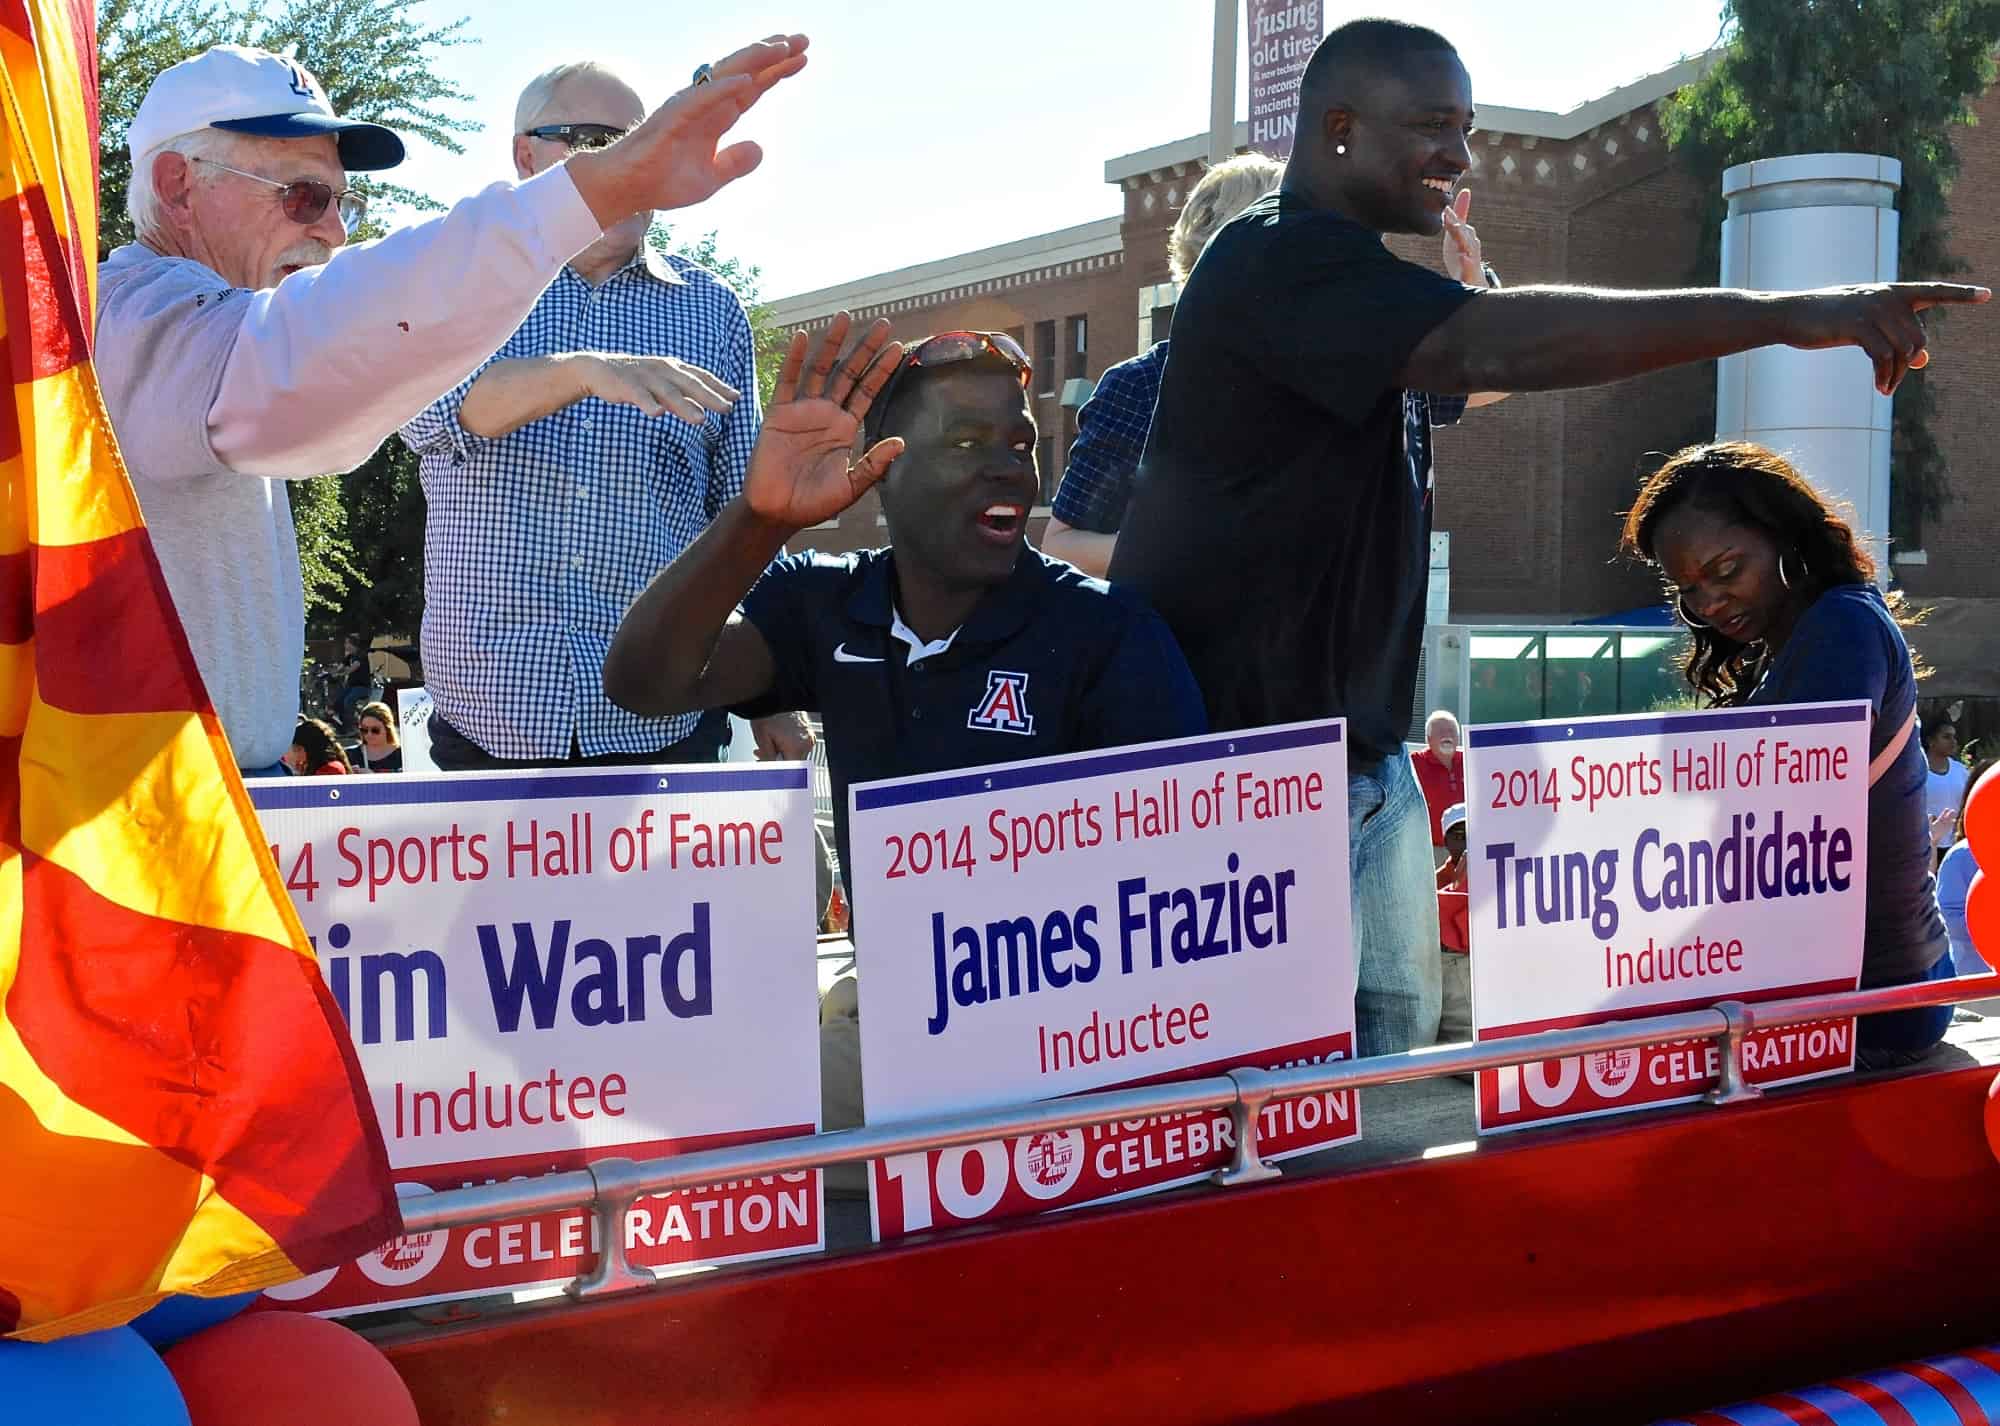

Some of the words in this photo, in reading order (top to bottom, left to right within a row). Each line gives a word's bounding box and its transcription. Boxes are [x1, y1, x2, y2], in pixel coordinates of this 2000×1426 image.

[1251, 1, 1318, 47] fusing
[1253, 39, 1279, 66] old
[1282, 34, 1319, 59] tires
[1254, 86, 1266, 98] to
[1254, 97, 1292, 116] ancient
[967, 670, 1033, 735] A
[1491, 767, 1561, 812] 2014
[1570, 751, 1662, 812] Sports
[1672, 741, 1726, 793] Hall
[1736, 738, 1765, 788] of
[1775, 740, 1849, 785] Fame
[336, 823, 489, 902] Sports
[507, 812, 593, 879] Hall
[608, 809, 654, 873] of
[669, 813, 783, 870] Fame
[885, 825, 976, 879] 2014
[989, 798, 1102, 873] Sports
[1114, 778, 1180, 842] Hall
[1191, 770, 1225, 829] of
[1236, 771, 1323, 825] Fame
[1486, 841, 1619, 940] Trung
[1632, 810, 1853, 912] Candidate
[309, 923, 447, 1045] im
[477, 901, 713, 1033] Ward
[927, 904, 1100, 1036] James
[1117, 851, 1295, 975] Frazier
[1605, 937, 1743, 988] Inductee
[1039, 1002, 1210, 1074] Inductee
[1648, 1025, 1847, 1086] CELERATION
[395, 1070, 627, 1139] Inductee
[1095, 1089, 1348, 1179] CELEBRTION
